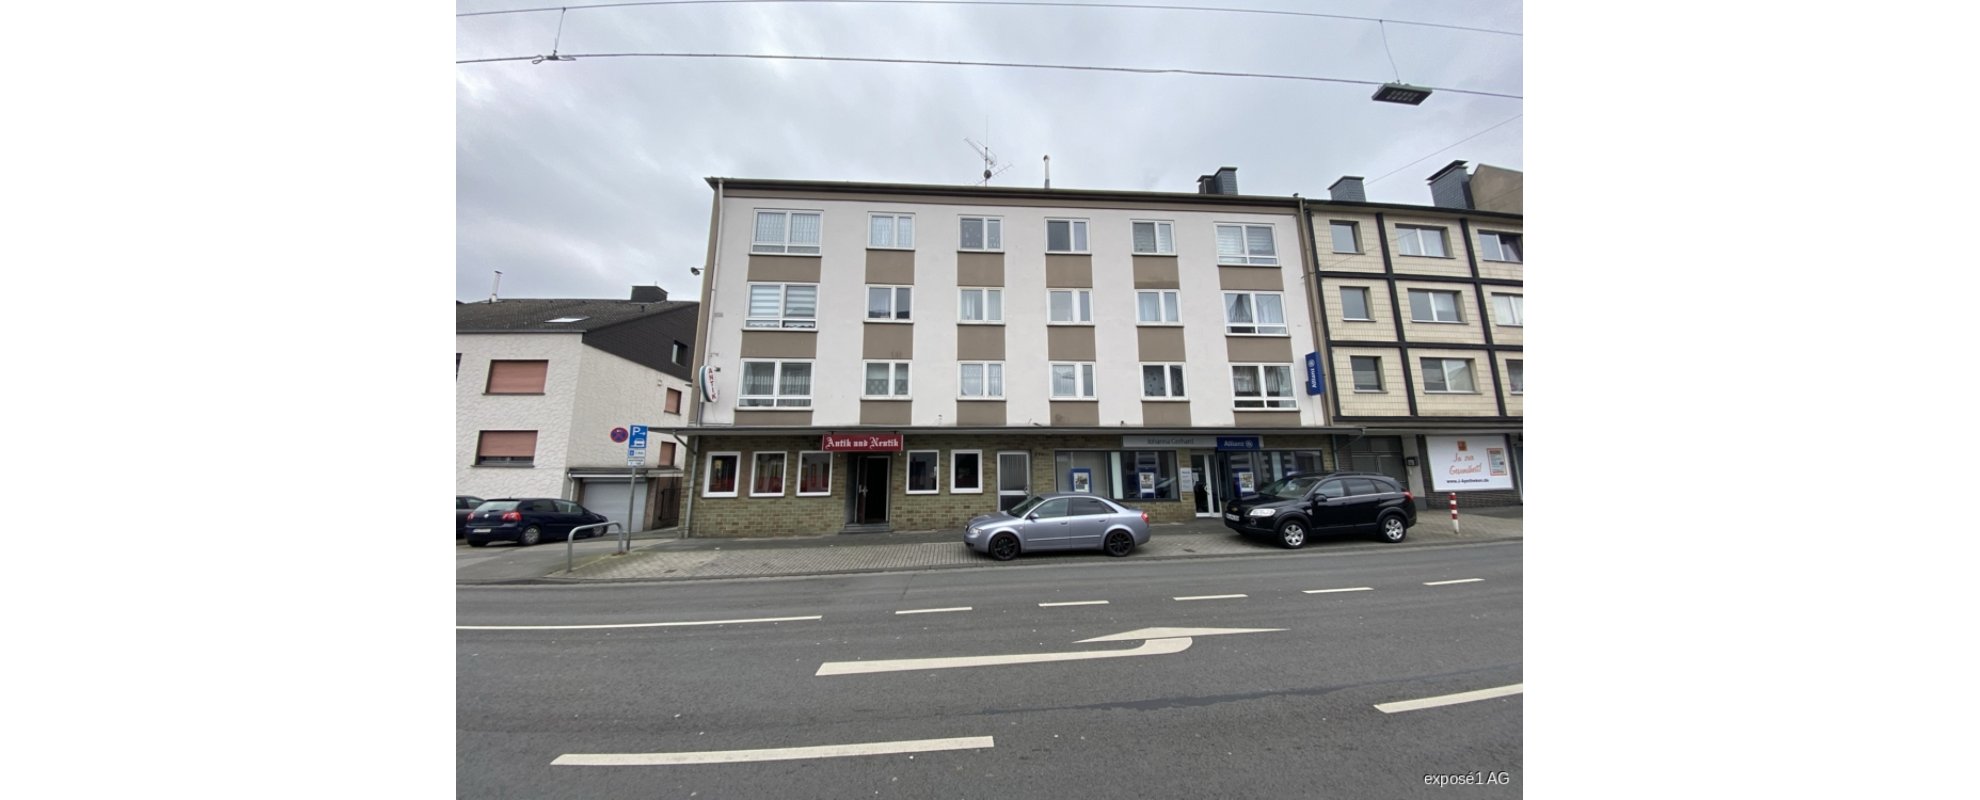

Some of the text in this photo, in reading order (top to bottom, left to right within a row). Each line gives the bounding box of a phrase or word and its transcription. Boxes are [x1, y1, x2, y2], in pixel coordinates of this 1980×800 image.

[632, 426, 641, 436] P
[825, 436, 852, 449] Antik
[853, 439, 868, 447] und
[1453, 453, 1462, 462] Ja
